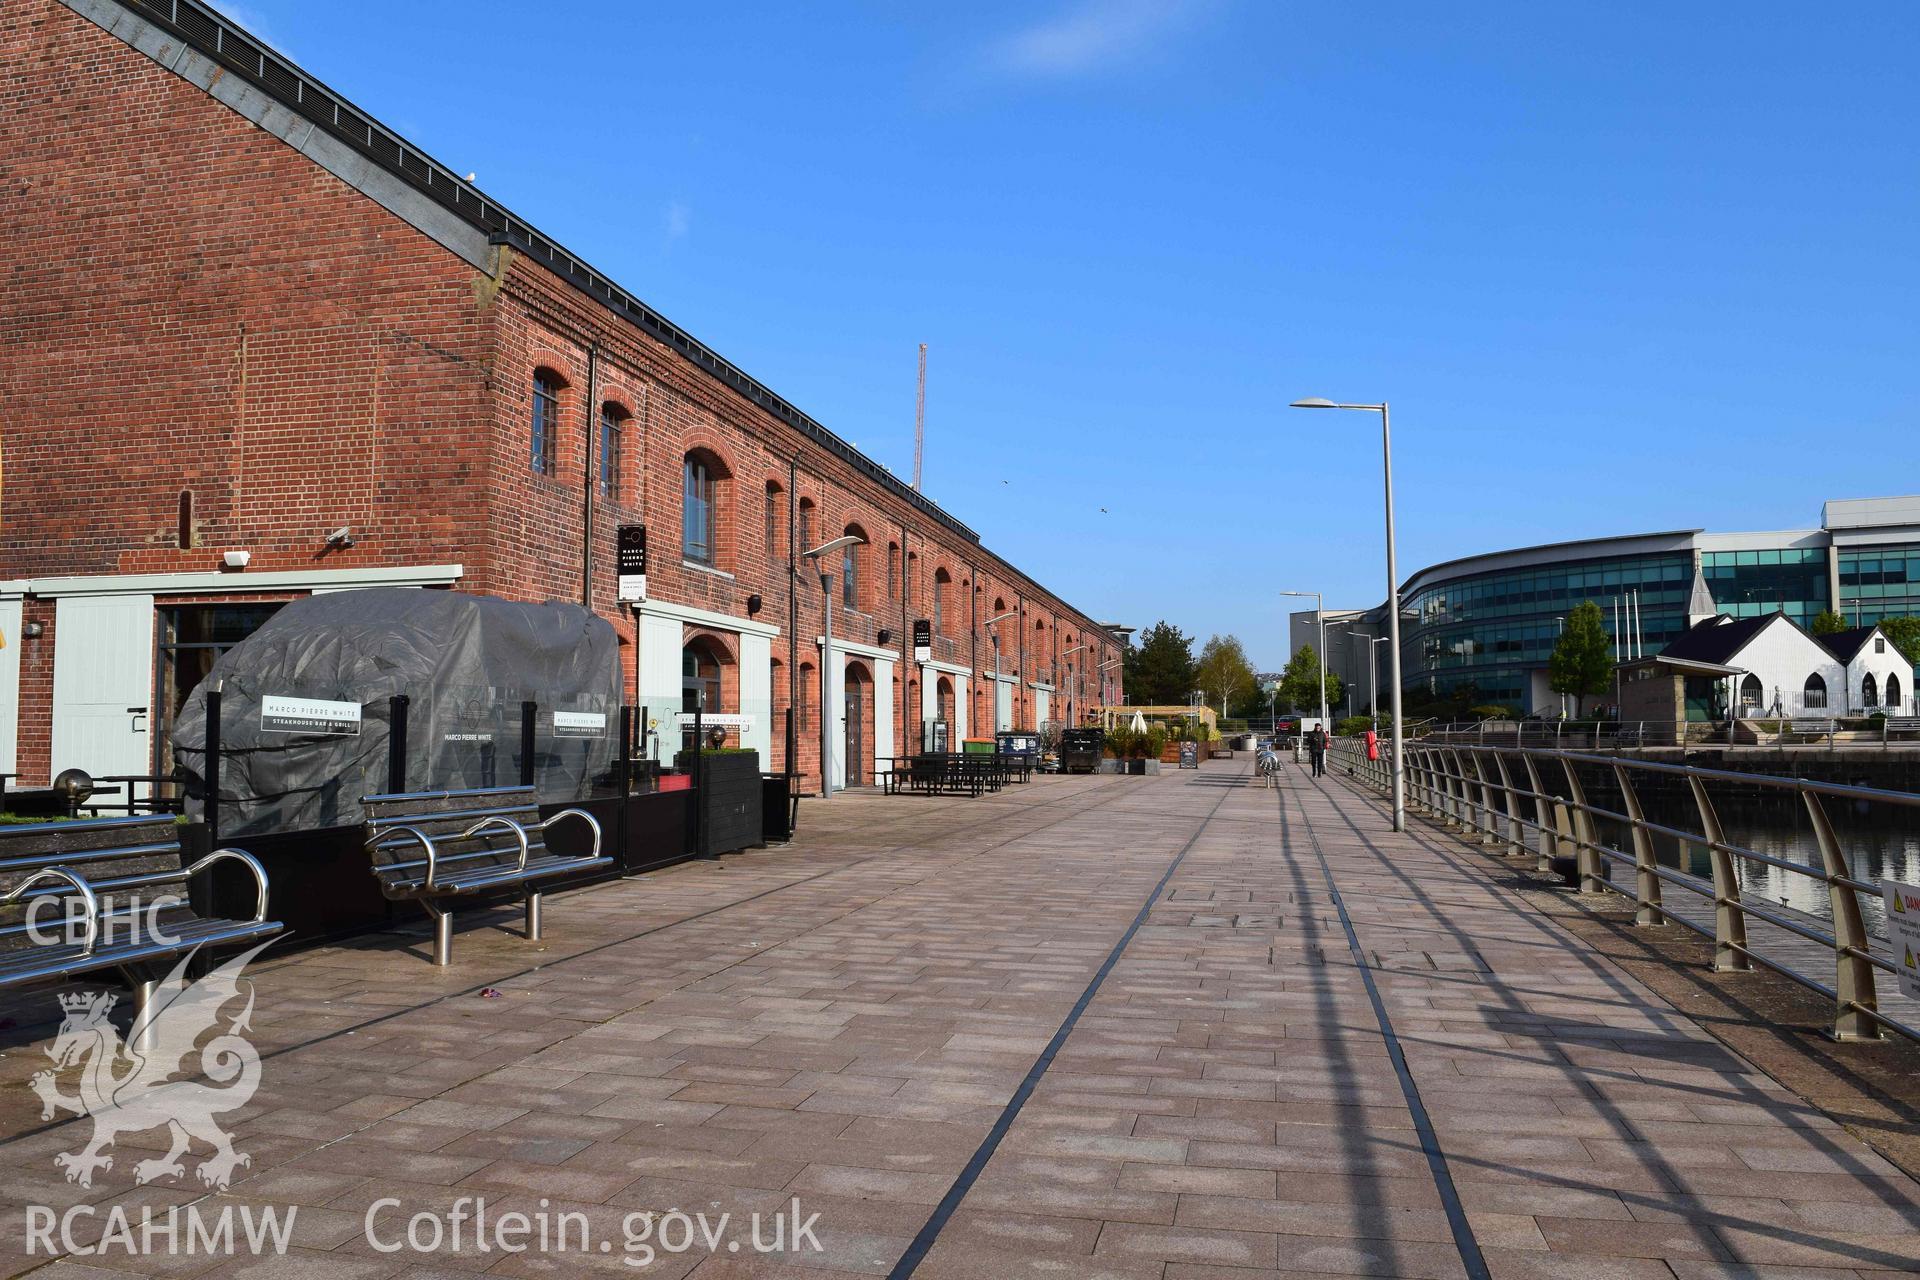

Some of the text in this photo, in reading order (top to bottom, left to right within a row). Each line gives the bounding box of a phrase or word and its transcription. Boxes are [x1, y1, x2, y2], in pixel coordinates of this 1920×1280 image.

[269, 705, 296, 713] MARCO
[301, 707, 328, 716] PIERRE
[272, 718, 313, 726] STEAKHOUSE
[1904, 896, 1920, 912] DAN
